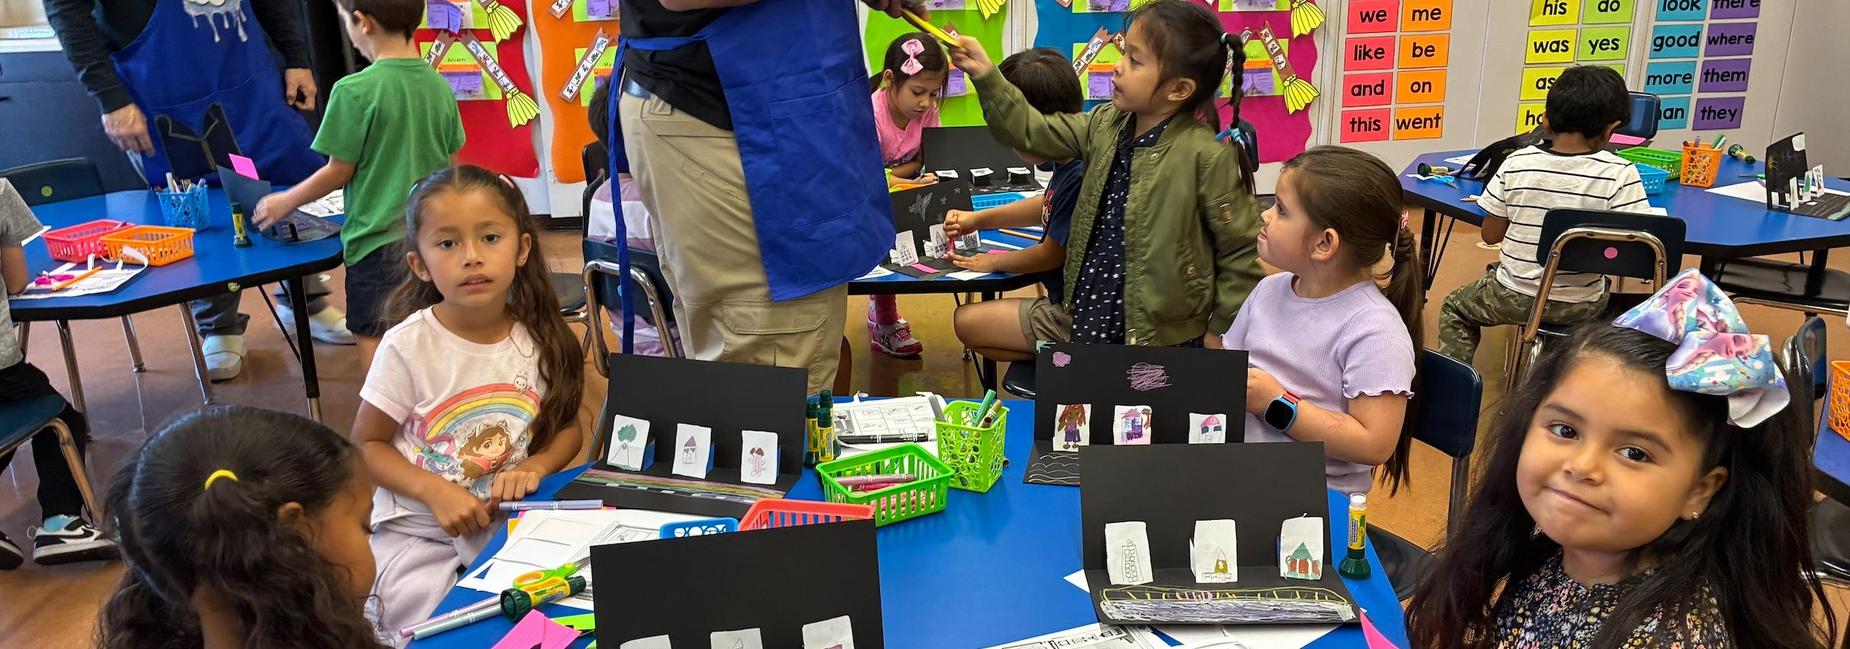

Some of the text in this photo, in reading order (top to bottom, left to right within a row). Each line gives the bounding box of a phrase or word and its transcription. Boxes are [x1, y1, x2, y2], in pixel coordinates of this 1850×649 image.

[1542, 0, 1567, 15] his
[1598, 0, 1620, 12] do
[1662, 0, 1701, 11] look
[1360, 9, 1387, 23] we
[1411, 7, 1441, 21] me
[1533, 39, 1569, 53] was
[1588, 37, 1620, 55] yes
[1653, 31, 1700, 52] good
[1707, 32, 1754, 45] where
[1354, 44, 1385, 61] like
[1412, 42, 1435, 58] be
[1646, 72, 1692, 85] more
[1703, 68, 1746, 83] them
[1351, 79, 1385, 96] and
[1410, 81, 1432, 93] on
[1658, 107, 1685, 120] an
[1700, 106, 1738, 122] they
[1349, 117, 1381, 132] this
[1396, 113, 1441, 130] went
